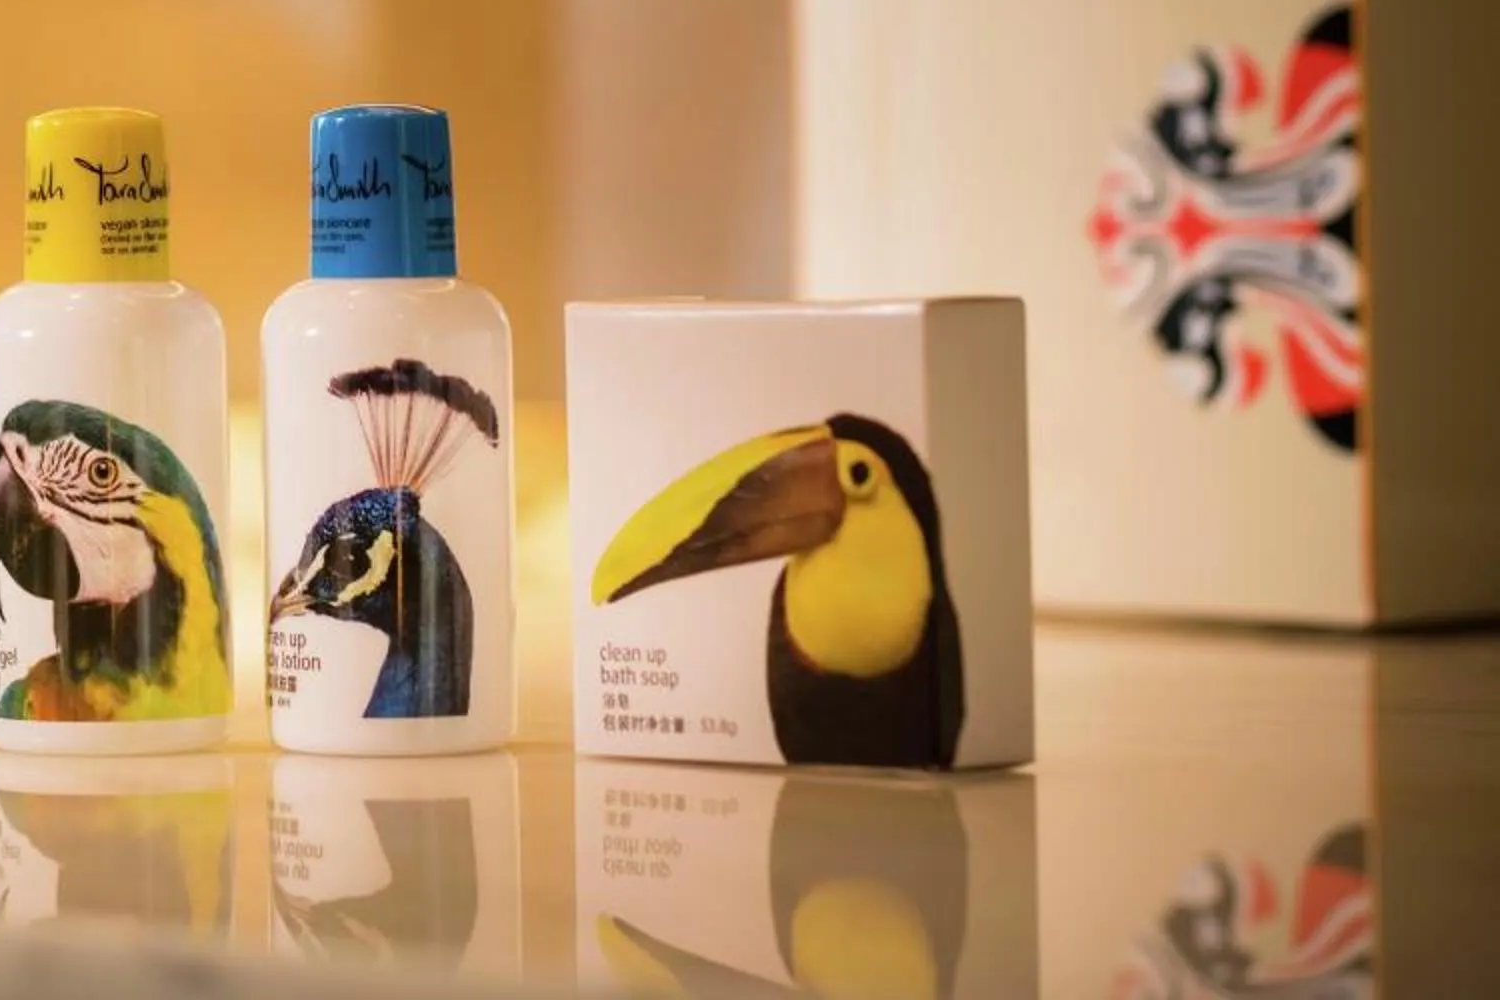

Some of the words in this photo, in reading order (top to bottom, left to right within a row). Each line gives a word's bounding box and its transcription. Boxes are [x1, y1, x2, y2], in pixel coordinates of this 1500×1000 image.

[73, 154, 137, 206] Tara
[326, 151, 391, 203] Smith
[100, 218, 138, 233] vegan
[289, 633, 307, 654] up
[600, 641, 642, 662] clean
[646, 647, 668, 668] up
[281, 650, 322, 672] lotion
[600, 664, 638, 686] bath
[640, 669, 680, 690] soap
